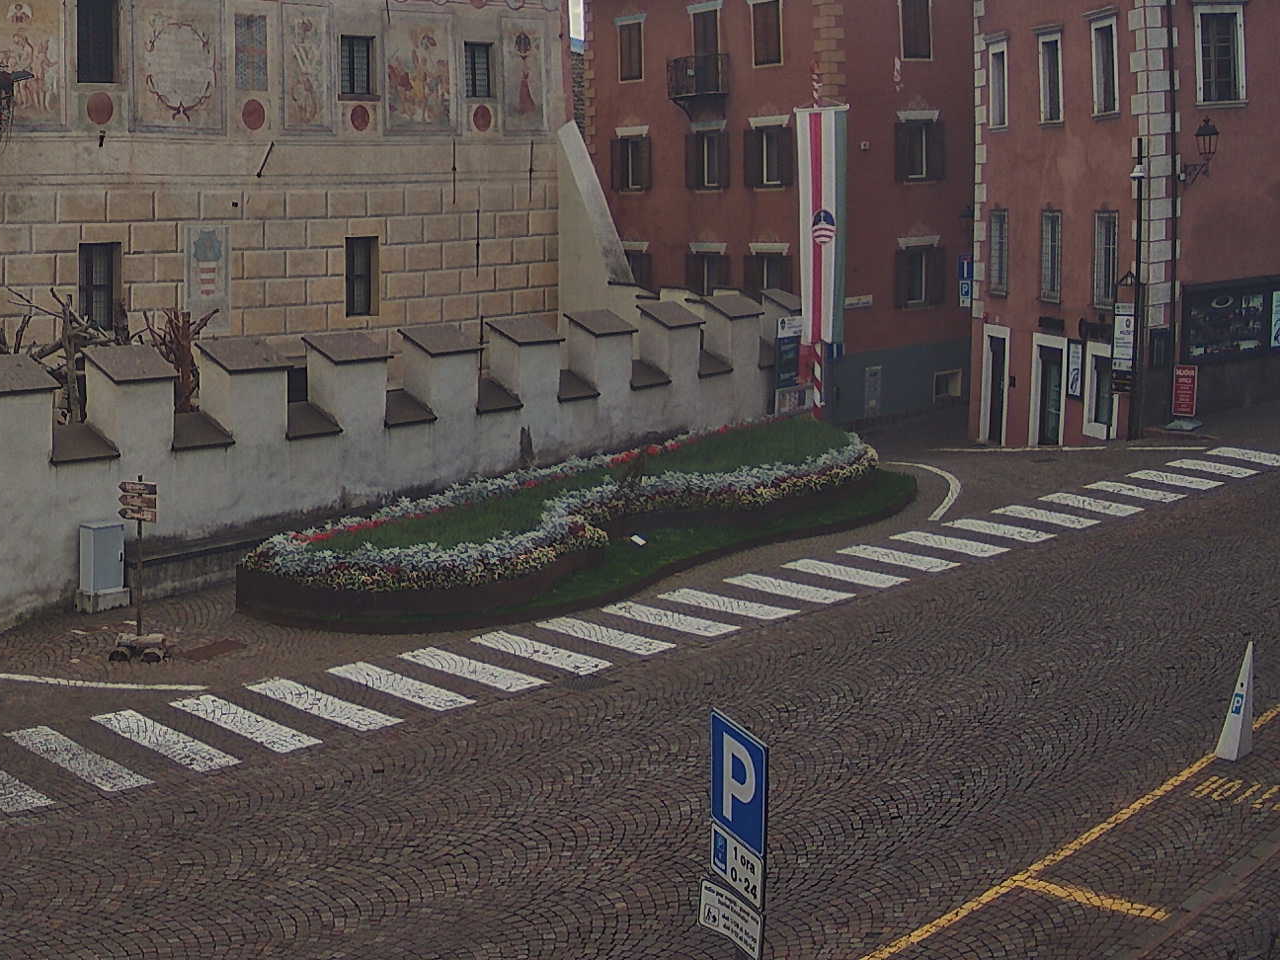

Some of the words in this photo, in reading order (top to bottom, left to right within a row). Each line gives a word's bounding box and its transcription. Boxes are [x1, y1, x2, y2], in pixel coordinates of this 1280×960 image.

[1233, 696, 1241, 712] P
[723, 731, 756, 822] P
[733, 846, 738, 861] 1
[740, 855, 755, 876] ora
